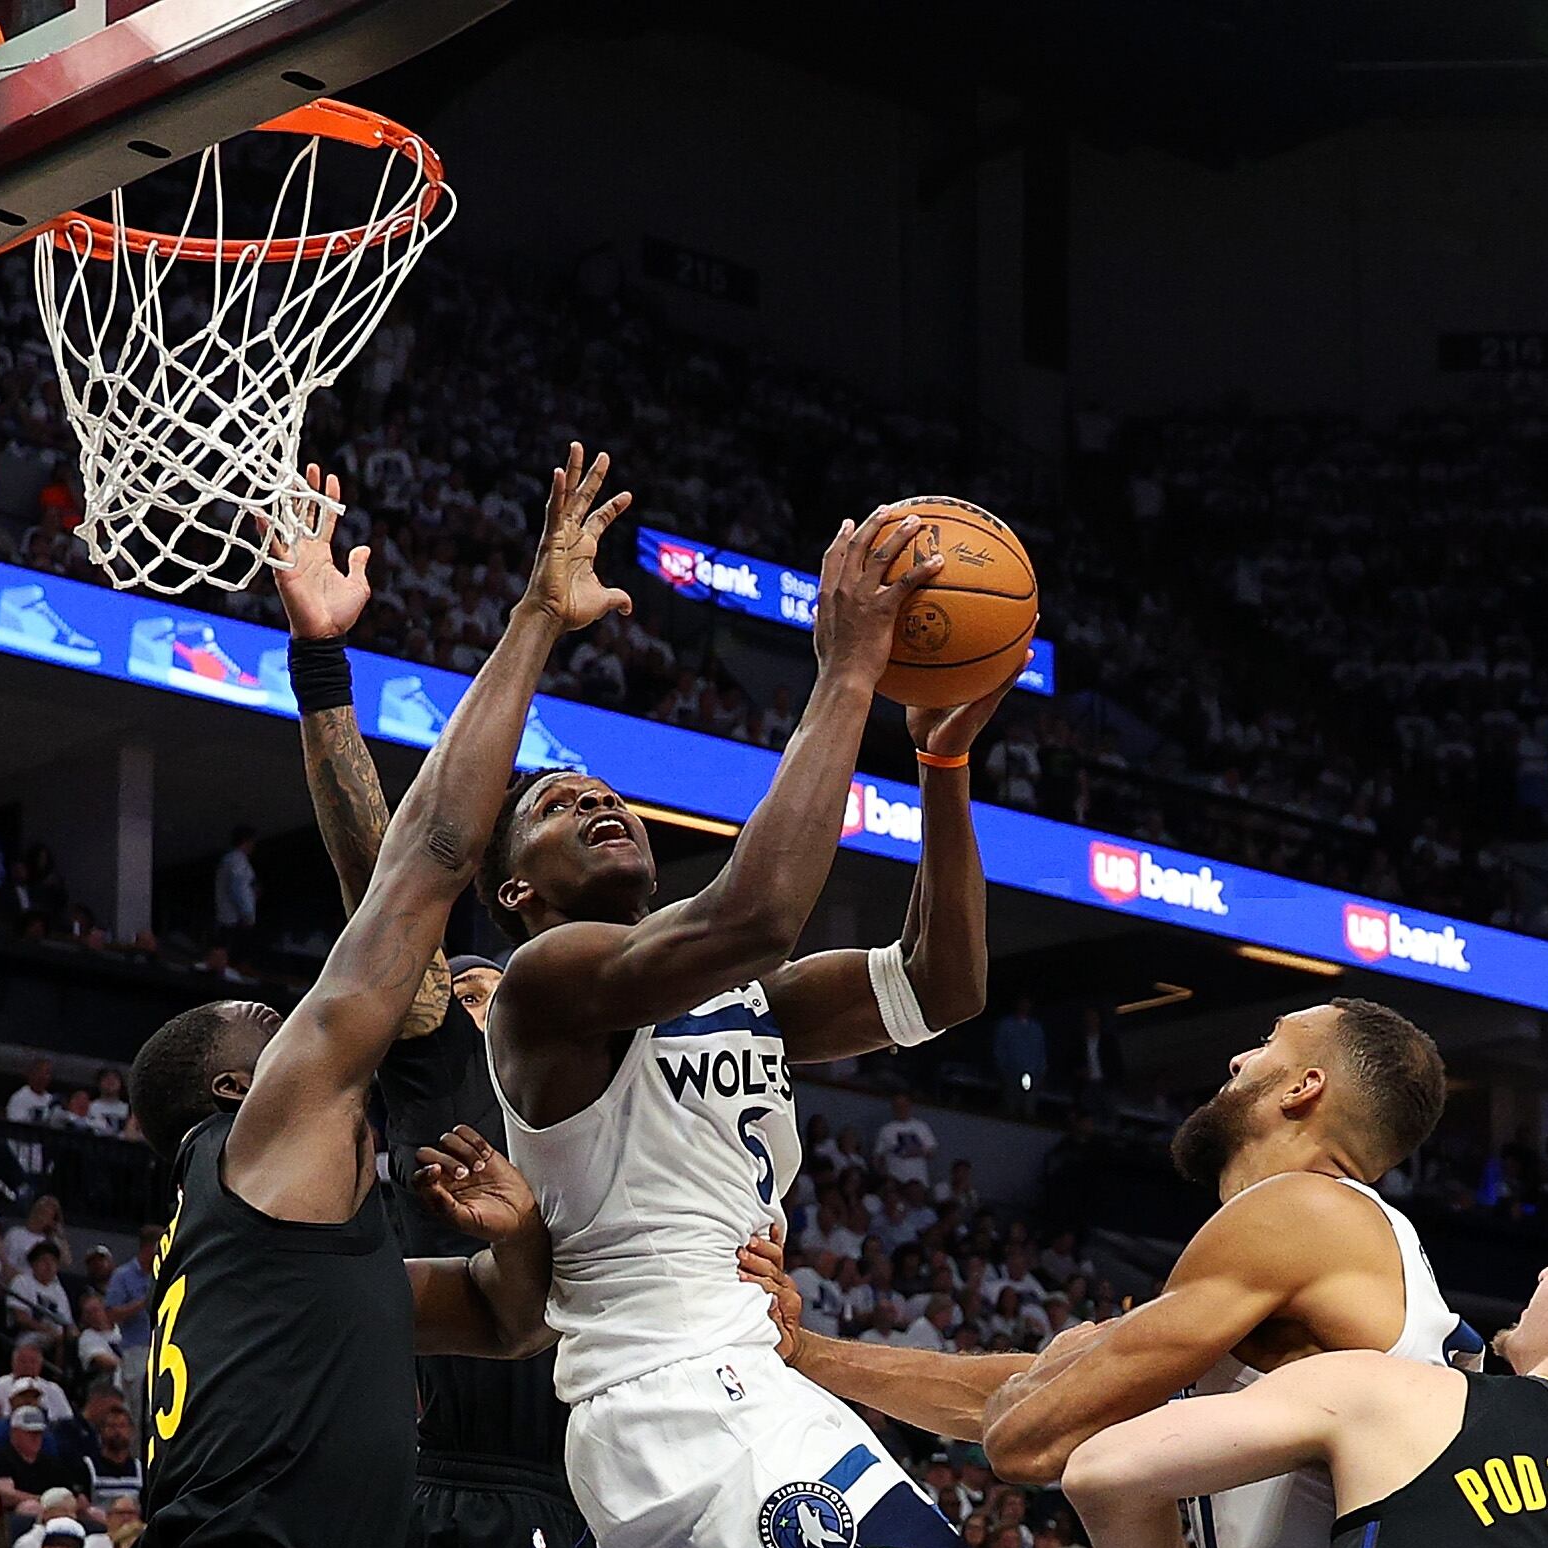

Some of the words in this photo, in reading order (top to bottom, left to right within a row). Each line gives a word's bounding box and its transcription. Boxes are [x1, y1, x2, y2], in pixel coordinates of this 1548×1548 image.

[1094, 851, 1137, 893] us
[1347, 912, 1388, 952] us
[773, 1482, 853, 1529] TIMBERWOLVES
